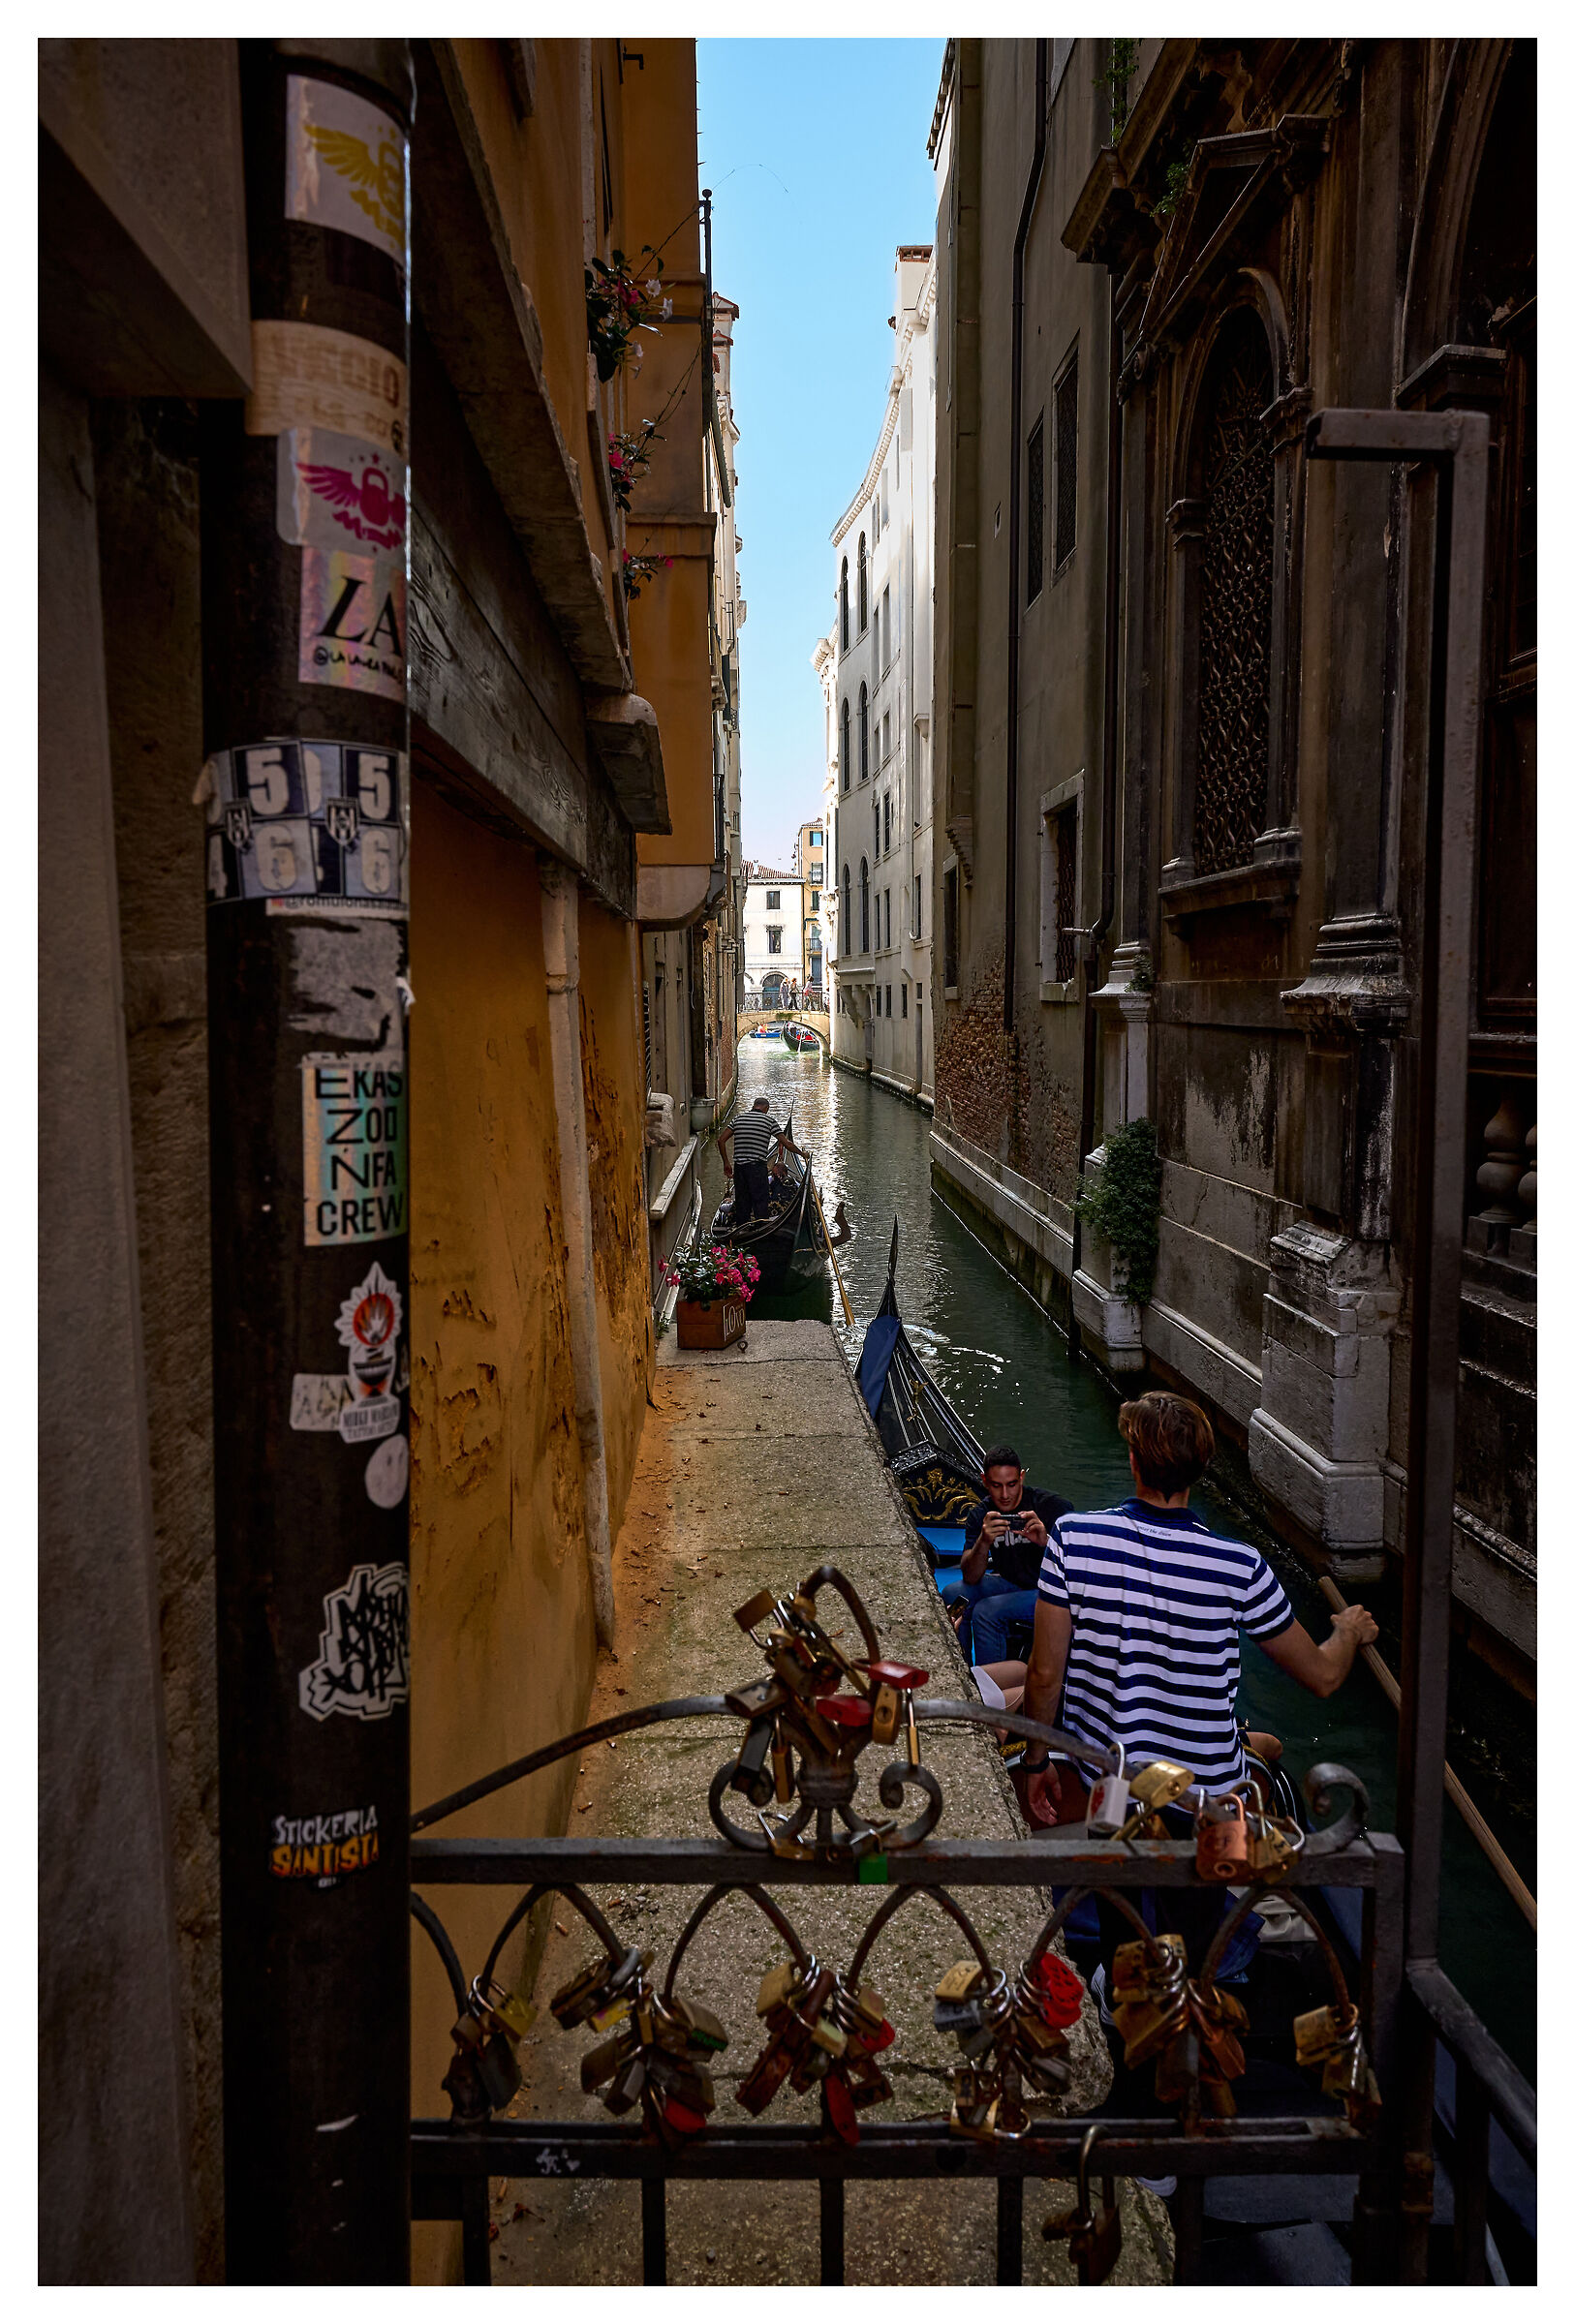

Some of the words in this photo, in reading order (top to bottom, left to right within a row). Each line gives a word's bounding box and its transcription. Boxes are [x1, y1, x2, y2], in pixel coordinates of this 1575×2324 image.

[316, 575, 404, 657] LA
[317, 1193, 403, 1236] CREW
[272, 1805, 379, 1847] STICKERIA
[270, 1831, 380, 1878] SANTISTA
